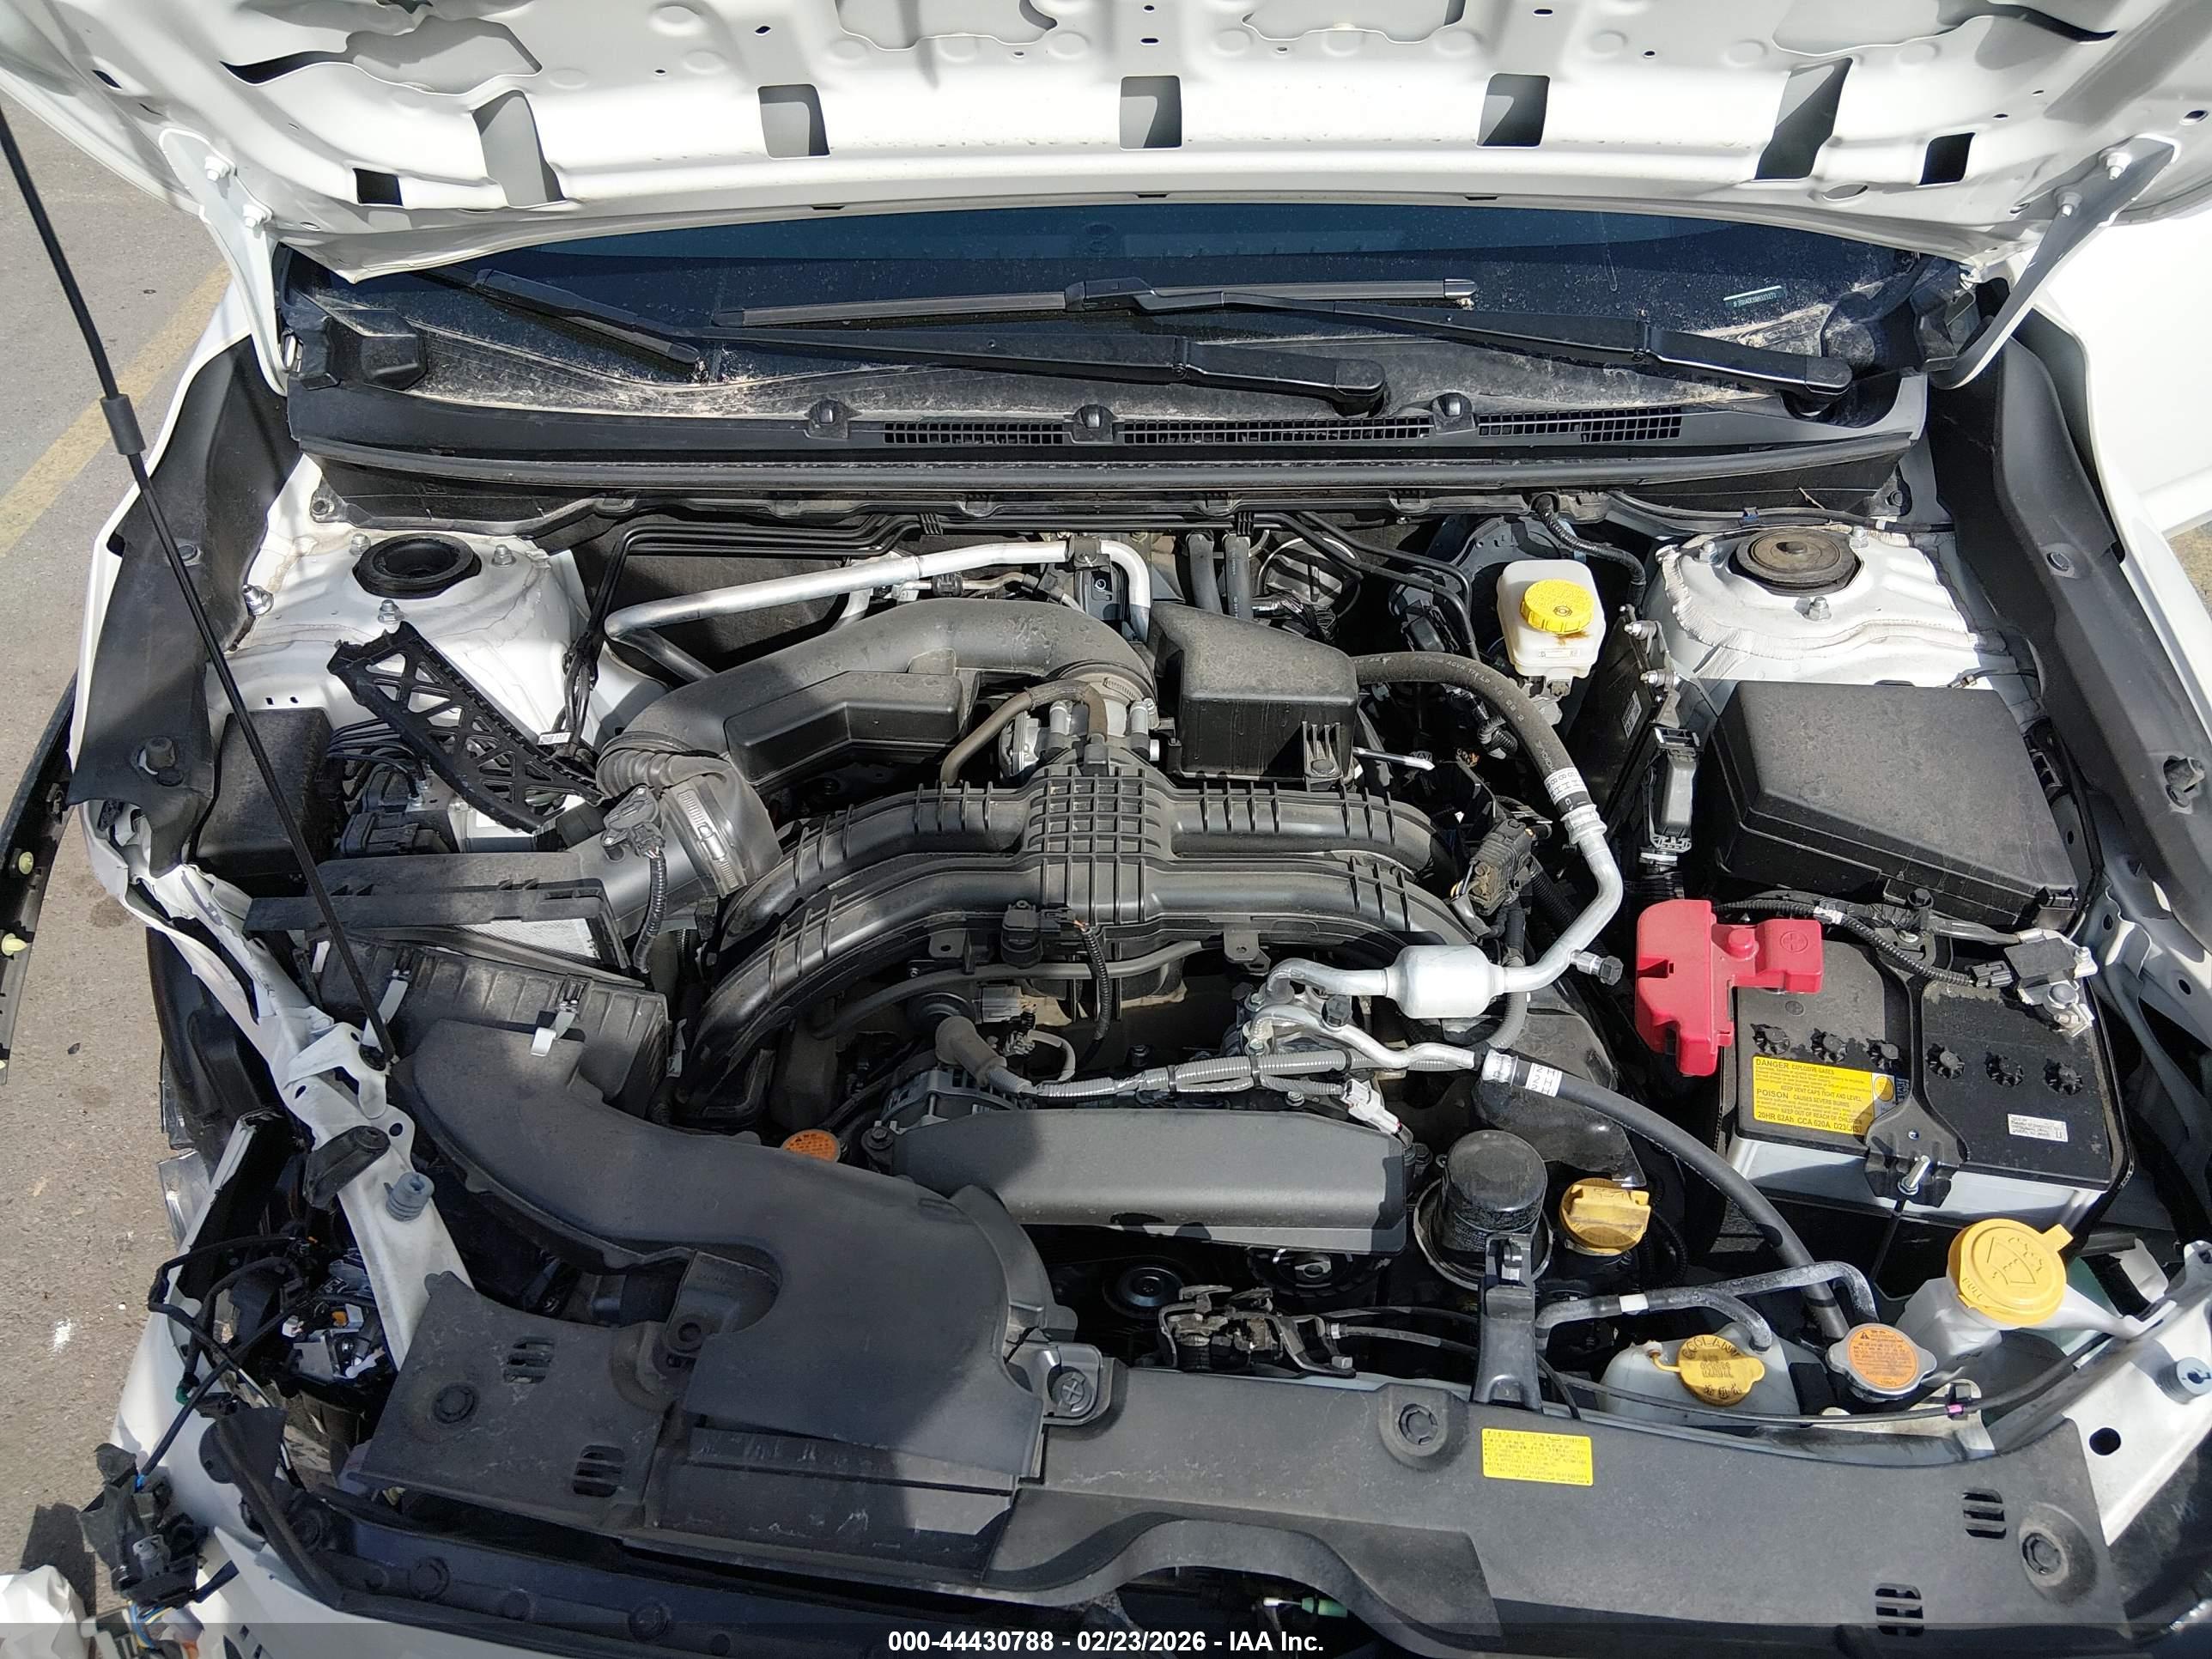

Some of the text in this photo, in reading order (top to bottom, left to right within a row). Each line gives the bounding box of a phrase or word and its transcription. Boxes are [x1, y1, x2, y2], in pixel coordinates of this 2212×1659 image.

[1756, 1059, 1789, 1070] DANGER
[1757, 1089, 1789, 1099] POISON
[1758, 1111, 1776, 1120] 20HR
[1797, 1117, 1813, 1126] CCA
[1682, 1337, 1741, 1359] COOLANT
